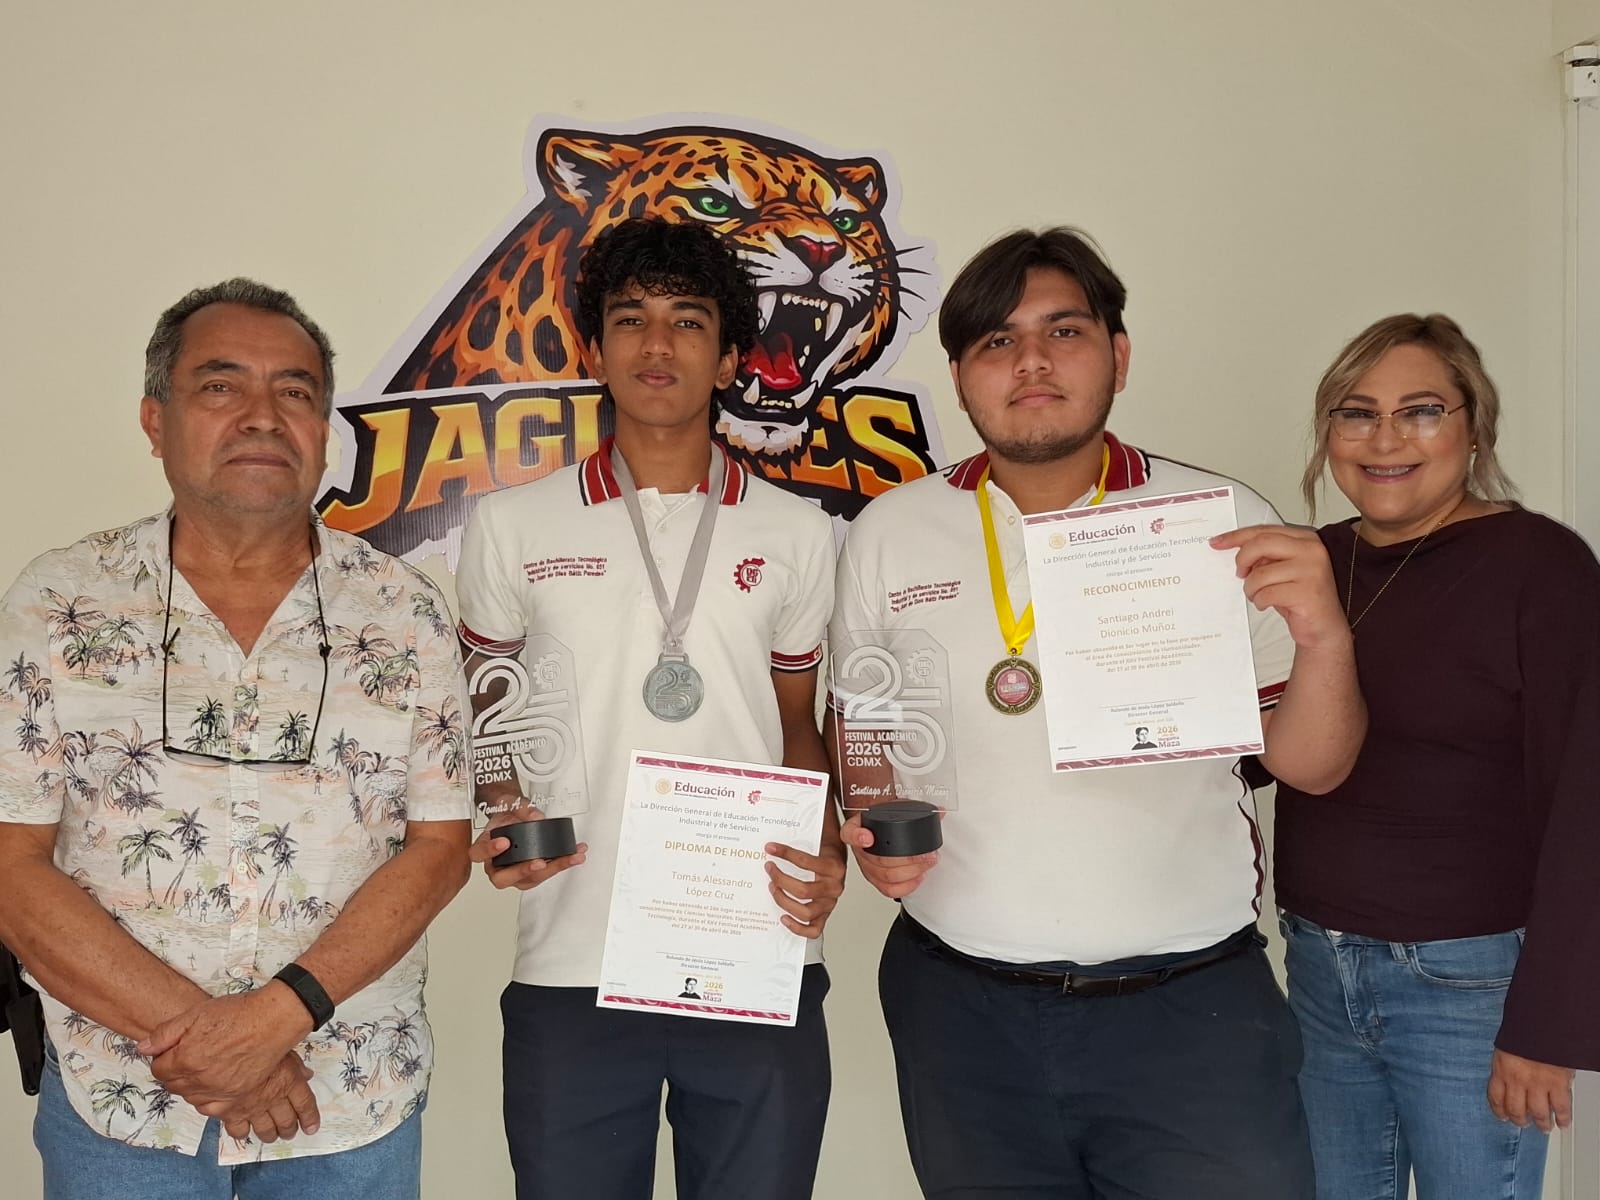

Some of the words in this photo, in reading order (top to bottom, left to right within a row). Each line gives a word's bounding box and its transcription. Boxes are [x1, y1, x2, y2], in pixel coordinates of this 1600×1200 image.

[320, 393, 928, 536] JAGES
[1068, 524, 1136, 542] Educación
[1052, 553, 1087, 563] Dirección
[1088, 548, 1117, 558] General
[1129, 541, 1167, 552] Educación
[1170, 536, 1210, 546] Tecnológic
[1085, 558, 1119, 568] Industrial
[1138, 552, 1171, 561] Servicios
[1083, 576, 1181, 597] RECONOCIMIENTO
[1097, 613, 1139, 625] Santiago
[1142, 608, 1174, 619] Andrei
[1100, 627, 1139, 638] Dionicio
[1142, 622, 1176, 633] Muñoz
[845, 732, 875, 741] FESTIVAL
[877, 730, 917, 742] ACADÉMICO
[474, 745, 505, 759] FESTIVAL
[846, 743, 881, 755] 2026
[475, 755, 511, 774] 2026
[847, 757, 882, 767] CDMX
[476, 770, 512, 784] CDMX
[674, 781, 735, 798] Educación
[850, 784, 881, 799] Santiago
[882, 784, 892, 796] A.
[478, 800, 508, 814] Tomás
[650, 803, 682, 813] Dirección
[684, 808, 712, 817] General
[724, 812, 758, 822] Educación
[761, 816, 800, 828] Tecnológica
[679, 817, 712, 827] Industrial
[729, 823, 760, 832] Servicios
[664, 840, 712, 854] DIPLOMA
[714, 846, 727, 856] DE
[730, 848, 767, 860] HONOR
[672, 871, 700, 882] Tomás
[704, 874, 752, 888] Alessandro
[686, 887, 712, 897] López
[714, 890, 734, 900] Cruz
